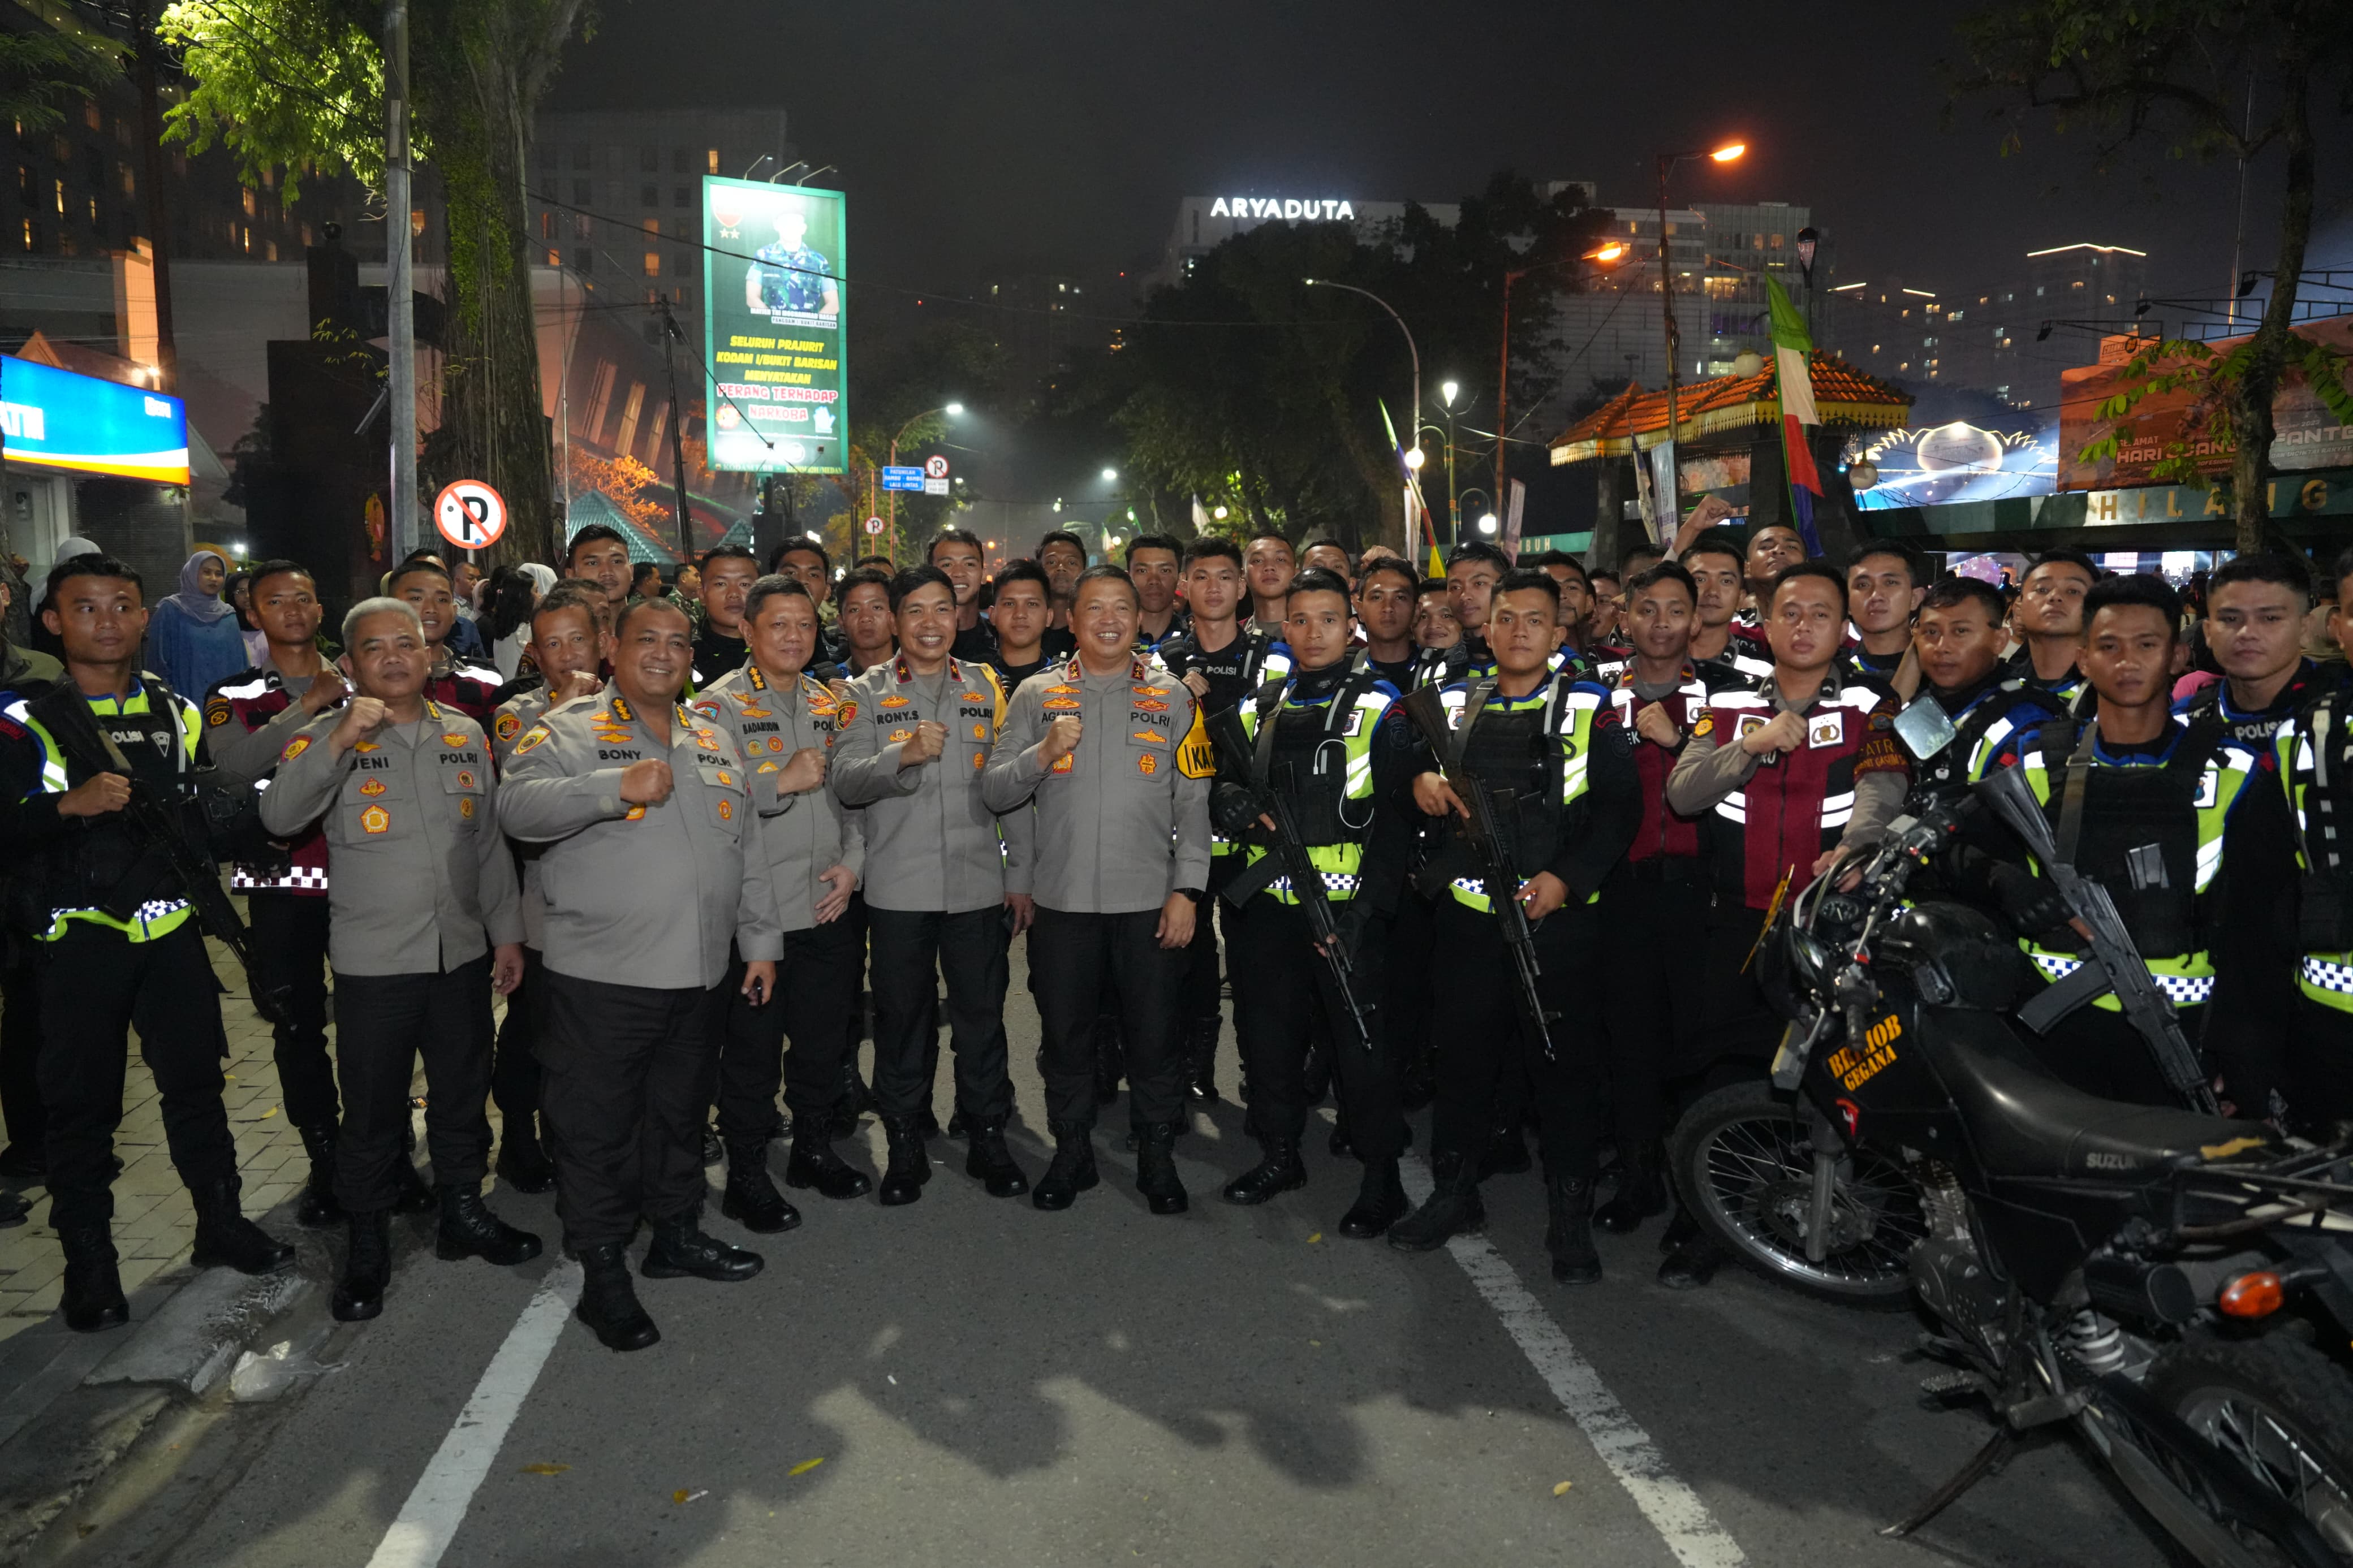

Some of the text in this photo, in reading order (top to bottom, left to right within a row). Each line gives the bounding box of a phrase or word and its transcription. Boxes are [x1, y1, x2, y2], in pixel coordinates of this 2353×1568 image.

[1210, 197, 1354, 219] ARYADUTA
[730, 335, 825, 352] SELURUH PRAJURIT
[716, 351, 837, 370] KODAM I/BUKIT BARISAN
[744, 370, 812, 384] MENYATAKAN
[717, 384, 838, 402] PERANG TERHADAP
[749, 405, 808, 421] NARKOBA
[2117, 448, 2162, 464] HARI
[463, 496, 488, 540] P
[1206, 666, 1237, 675] POLISI
[877, 710, 919, 725] RONY.S
[960, 707, 993, 719] POLRI
[1130, 712, 1170, 727] POLRI
[813, 720, 835, 731] POL
[2235, 720, 2283, 742] POLIS
[111, 730, 145, 743] OLISI
[439, 753, 477, 764] POLRI
[598, 749, 641, 760] BONY
[697, 754, 733, 768] POLRI
[1843, 1044, 1898, 1092] GEGANA
